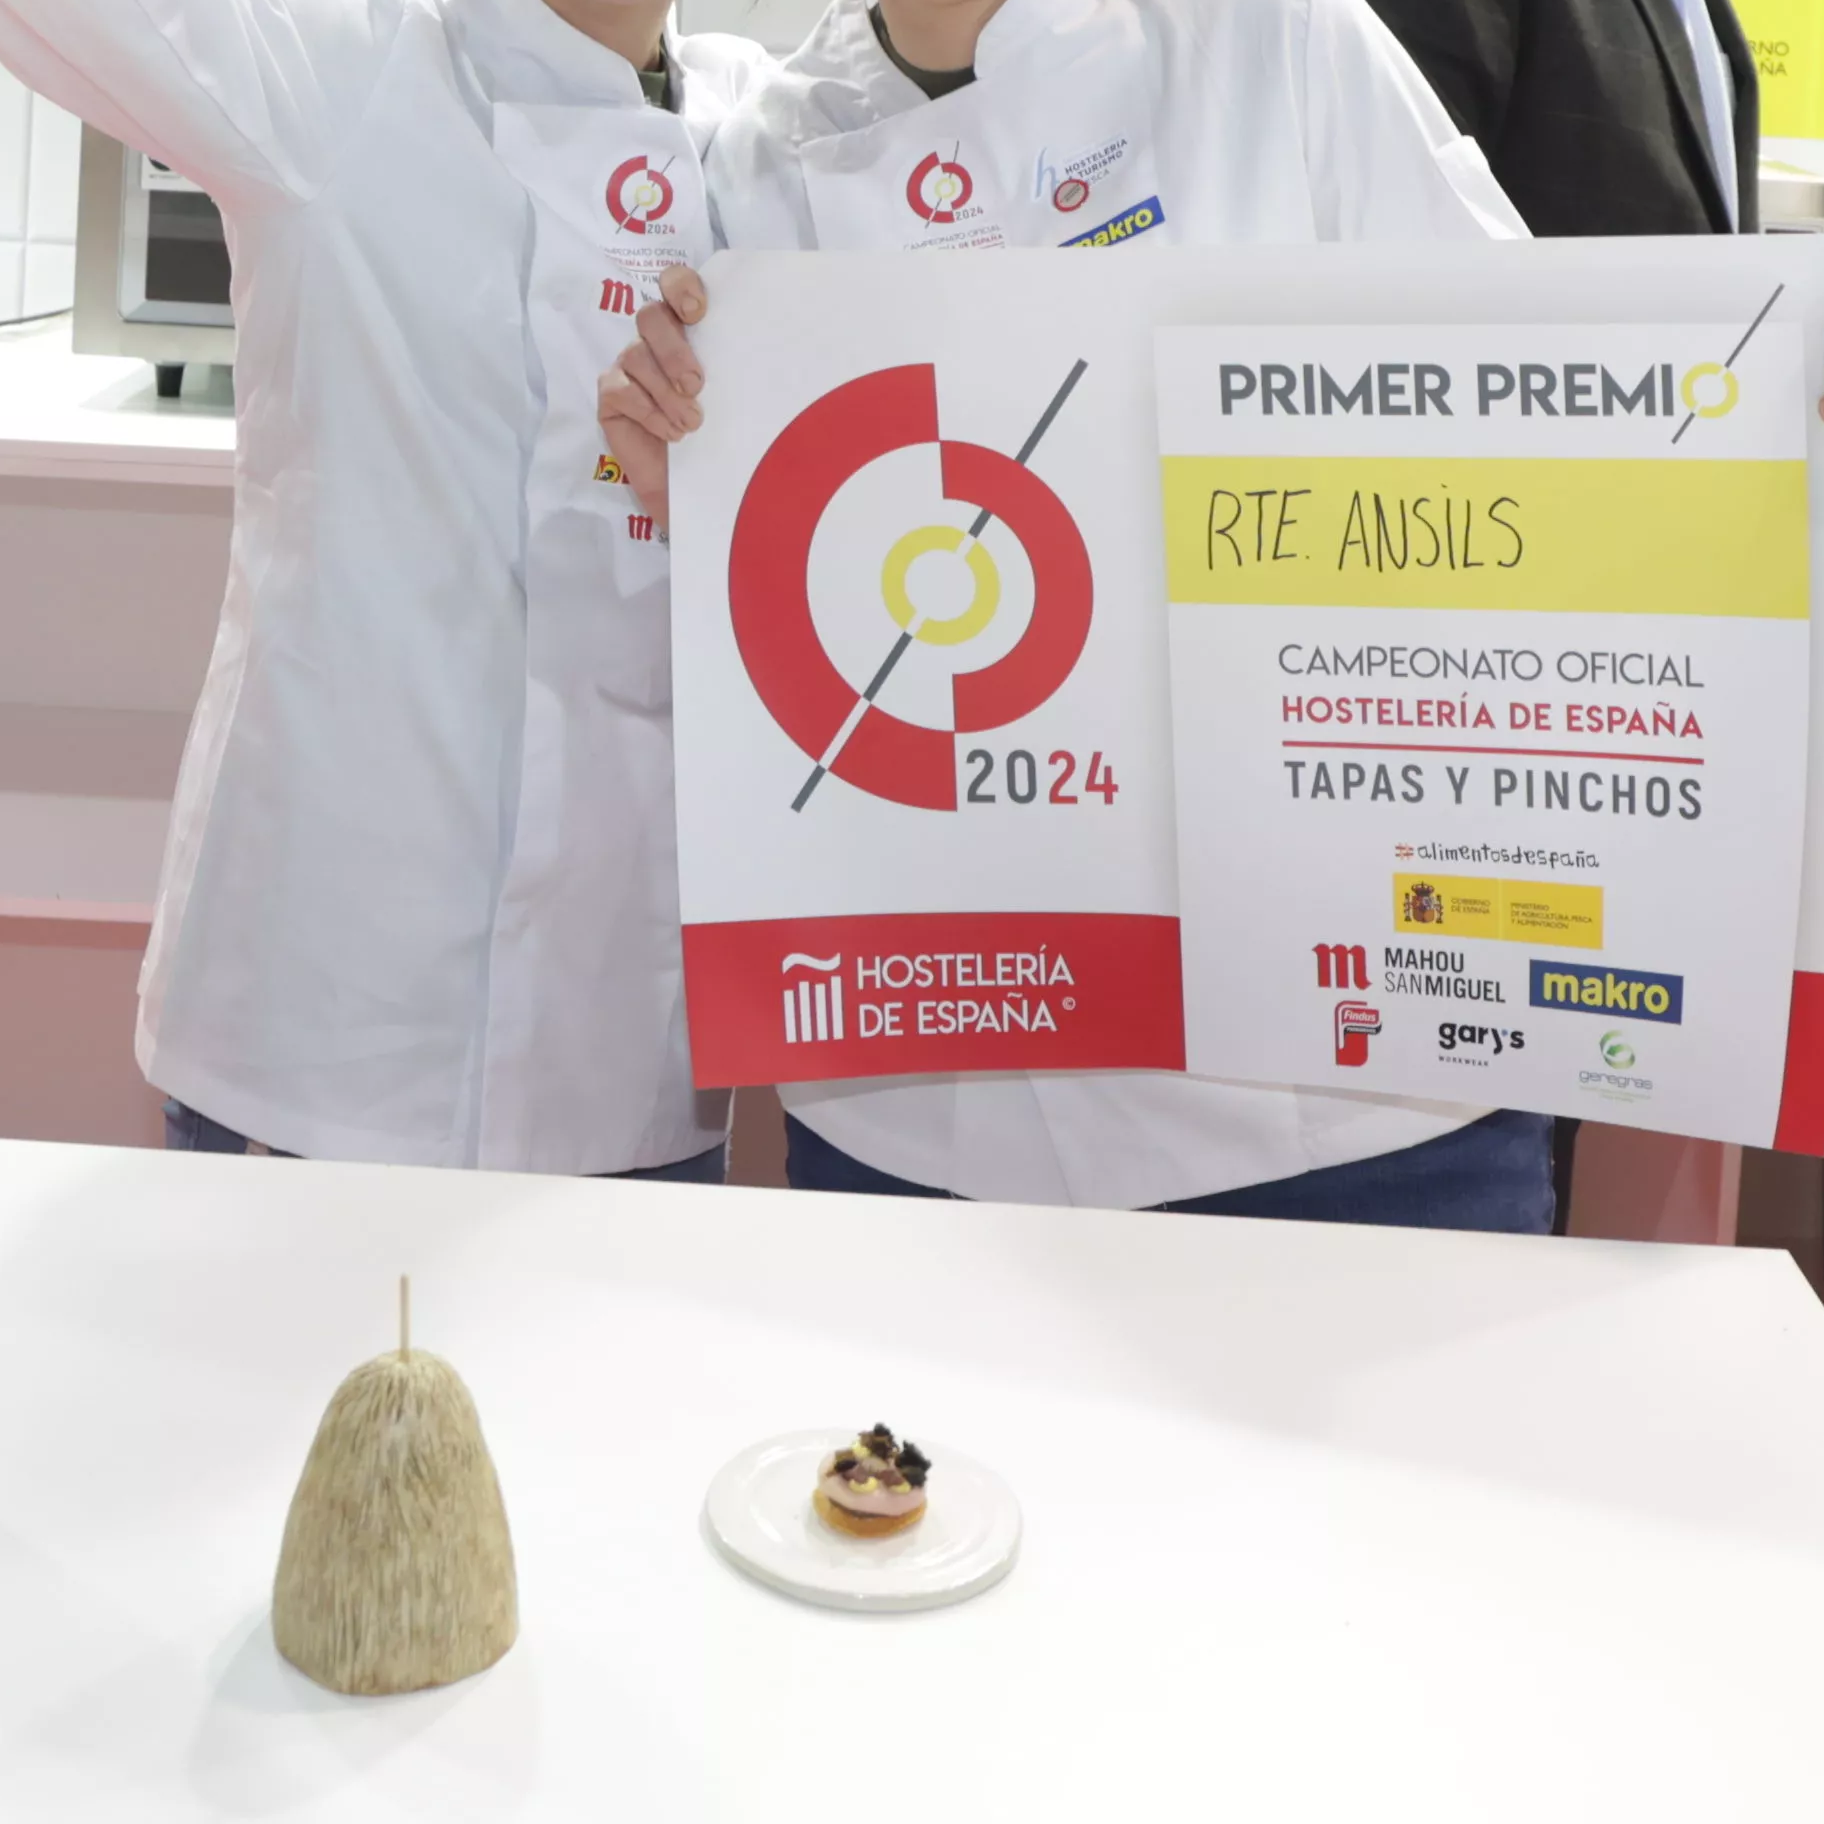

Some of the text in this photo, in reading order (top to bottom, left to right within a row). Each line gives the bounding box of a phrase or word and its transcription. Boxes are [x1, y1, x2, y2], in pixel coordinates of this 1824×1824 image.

[648, 224, 675, 234] 2024
[956, 207, 983, 221] 2024
[1220, 362, 1738, 419] PRIMER PREMIO
[1206, 489, 1311, 570] RTE.
[1278, 644, 1704, 687] CAMPEONATO OFICIAL
[1282, 693, 1703, 739] HOSTELERÍA DE ESPAÑA
[967, 749, 1119, 805] 2024
[1284, 760, 1703, 820] TAPAS Y PINCHOS
[857, 943, 1074, 988] HOSTELERÍA
[1384, 947, 1464, 974] MAHOU
[1384, 972, 1506, 1004] SANMIGUEL
[1543, 971, 1669, 1015] makro
[860, 993, 1057, 1038] DE ESPAÑA
[1343, 1010, 1376, 1022] Findus
[1439, 1056, 1488, 1066] WORKWEAR
